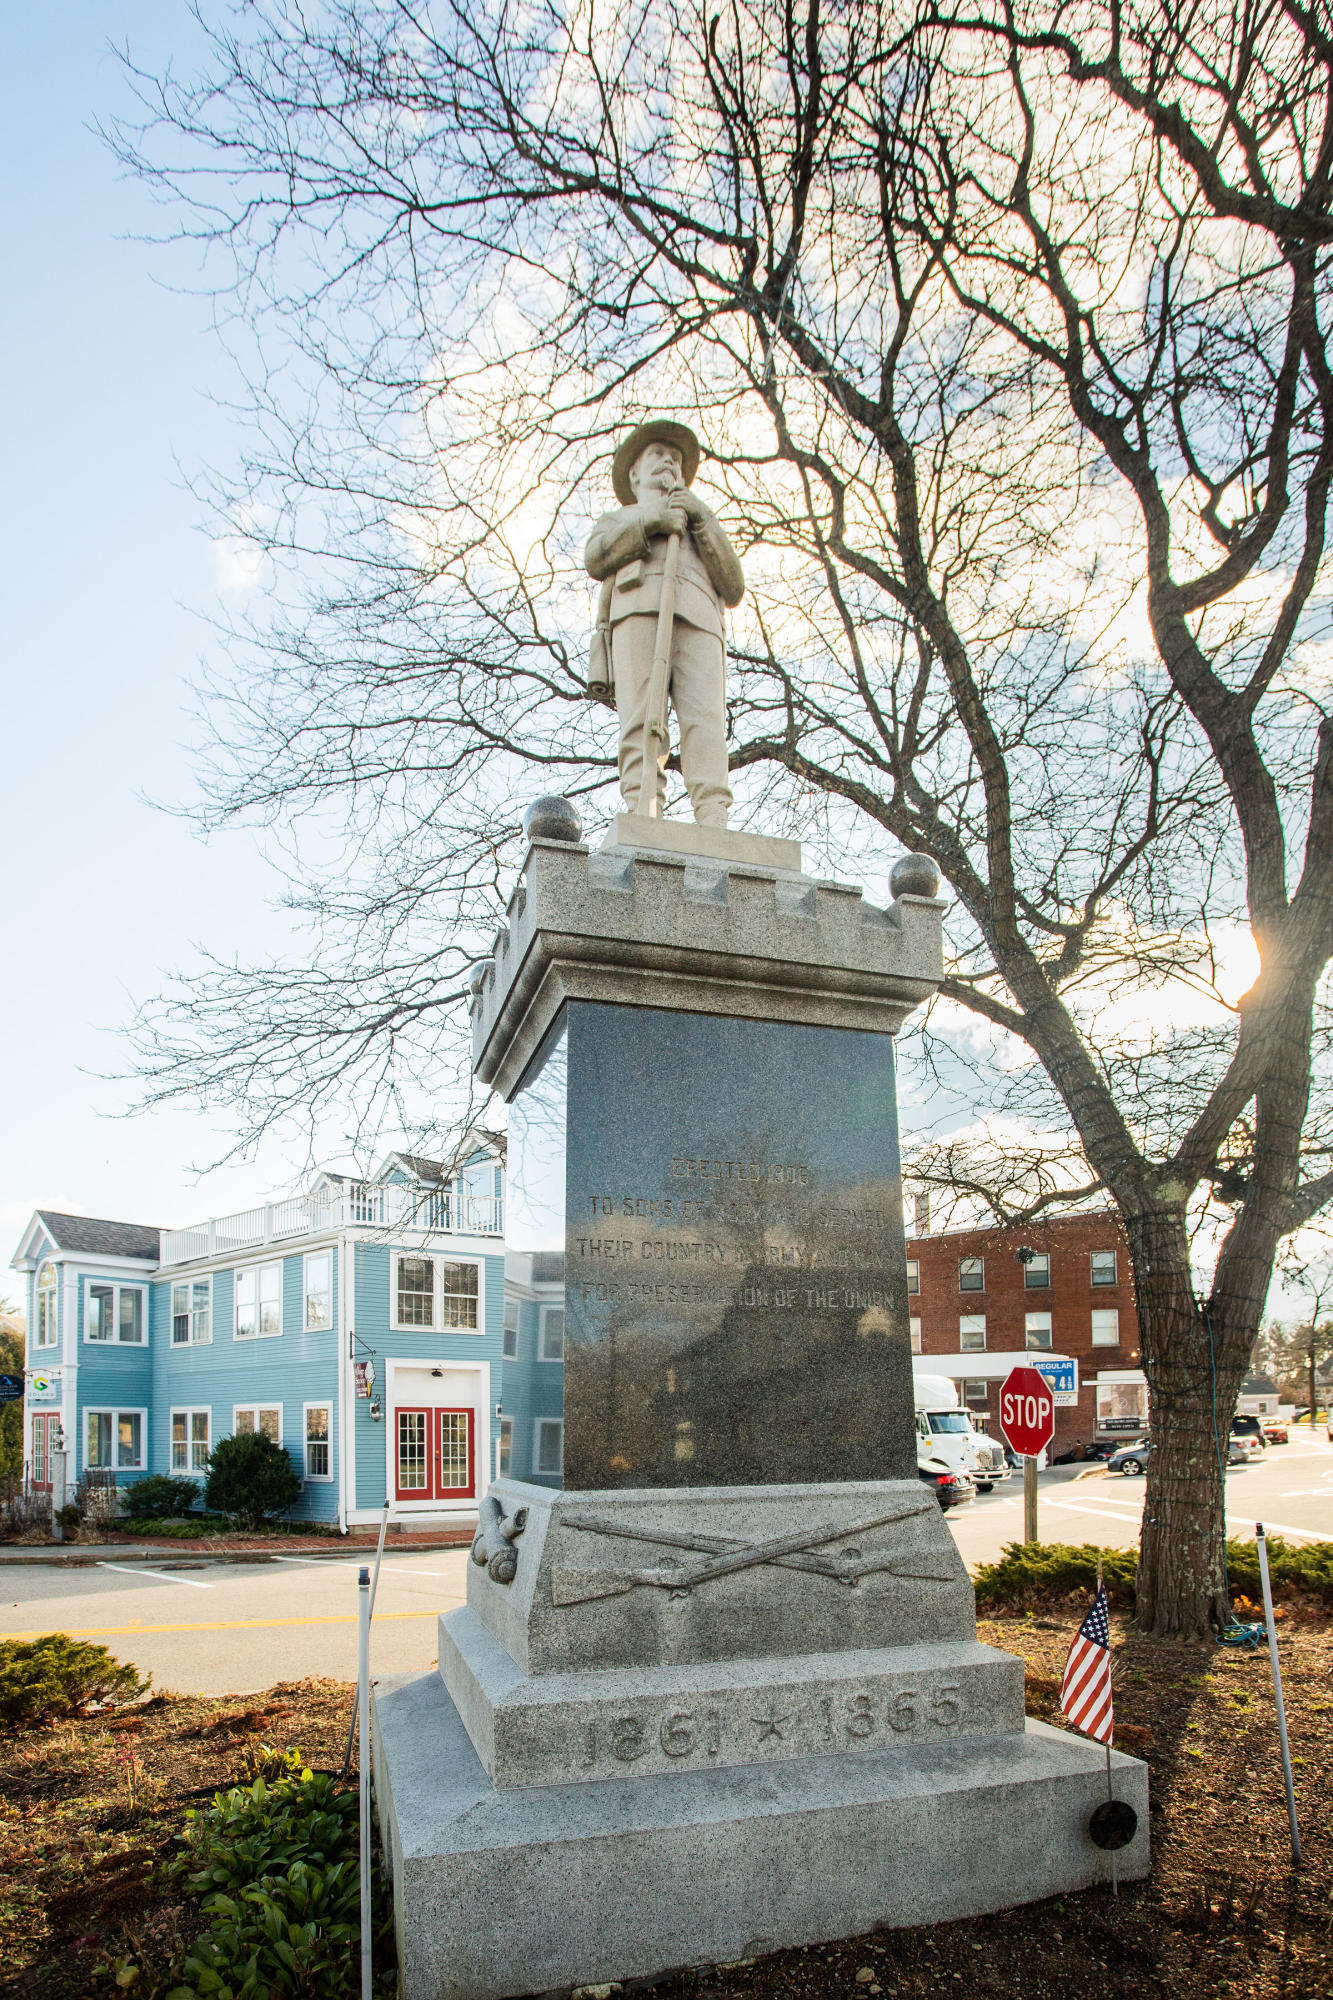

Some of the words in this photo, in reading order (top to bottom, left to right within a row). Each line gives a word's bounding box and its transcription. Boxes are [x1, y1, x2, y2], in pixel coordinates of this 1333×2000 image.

[672, 1157, 760, 1181] ERECTED
[589, 1196, 613, 1216] TO
[622, 1197, 673, 1218] SONS
[682, 1200, 704, 1219] OF
[818, 1206, 886, 1229] SERVED
[575, 1238, 633, 1260] THEIR
[641, 1240, 726, 1263] COUNTRY
[582, 1282, 621, 1302] FOR
[775, 1288, 799, 1308] OF
[803, 1288, 839, 1308] THE
[844, 1289, 895, 1309] UNION
[1003, 1393, 1050, 1430] STOP
[580, 1709, 722, 1769] 1861
[819, 1682, 960, 1742] 1865
